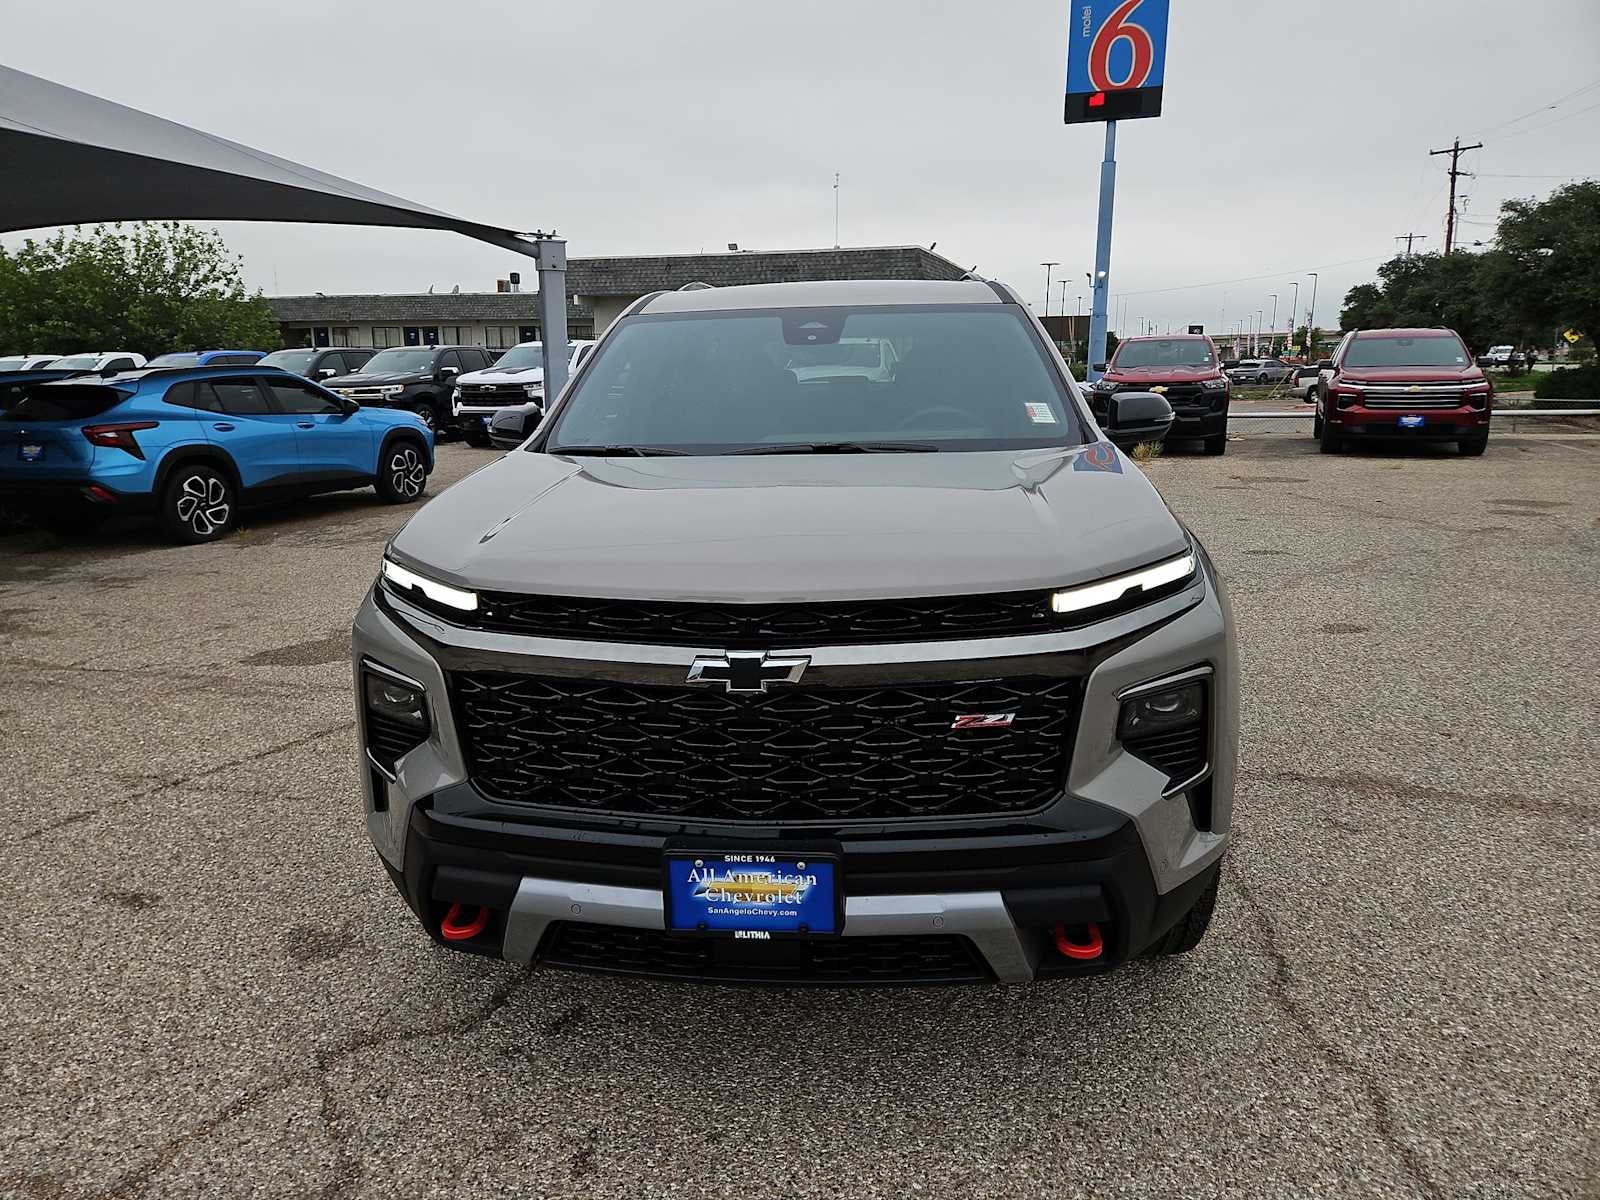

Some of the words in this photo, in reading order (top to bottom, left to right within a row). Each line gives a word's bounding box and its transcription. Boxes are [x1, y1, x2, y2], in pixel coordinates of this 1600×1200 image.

[1082, 6, 1092, 38] motel
[1088, 0, 1154, 91] 6
[724, 855, 753, 863] SINCE
[687, 868, 715, 883] All
[723, 869, 817, 886] American
[704, 887, 803, 905] Chevrolet
[707, 906, 798, 917] SanAngeloChevy.com
